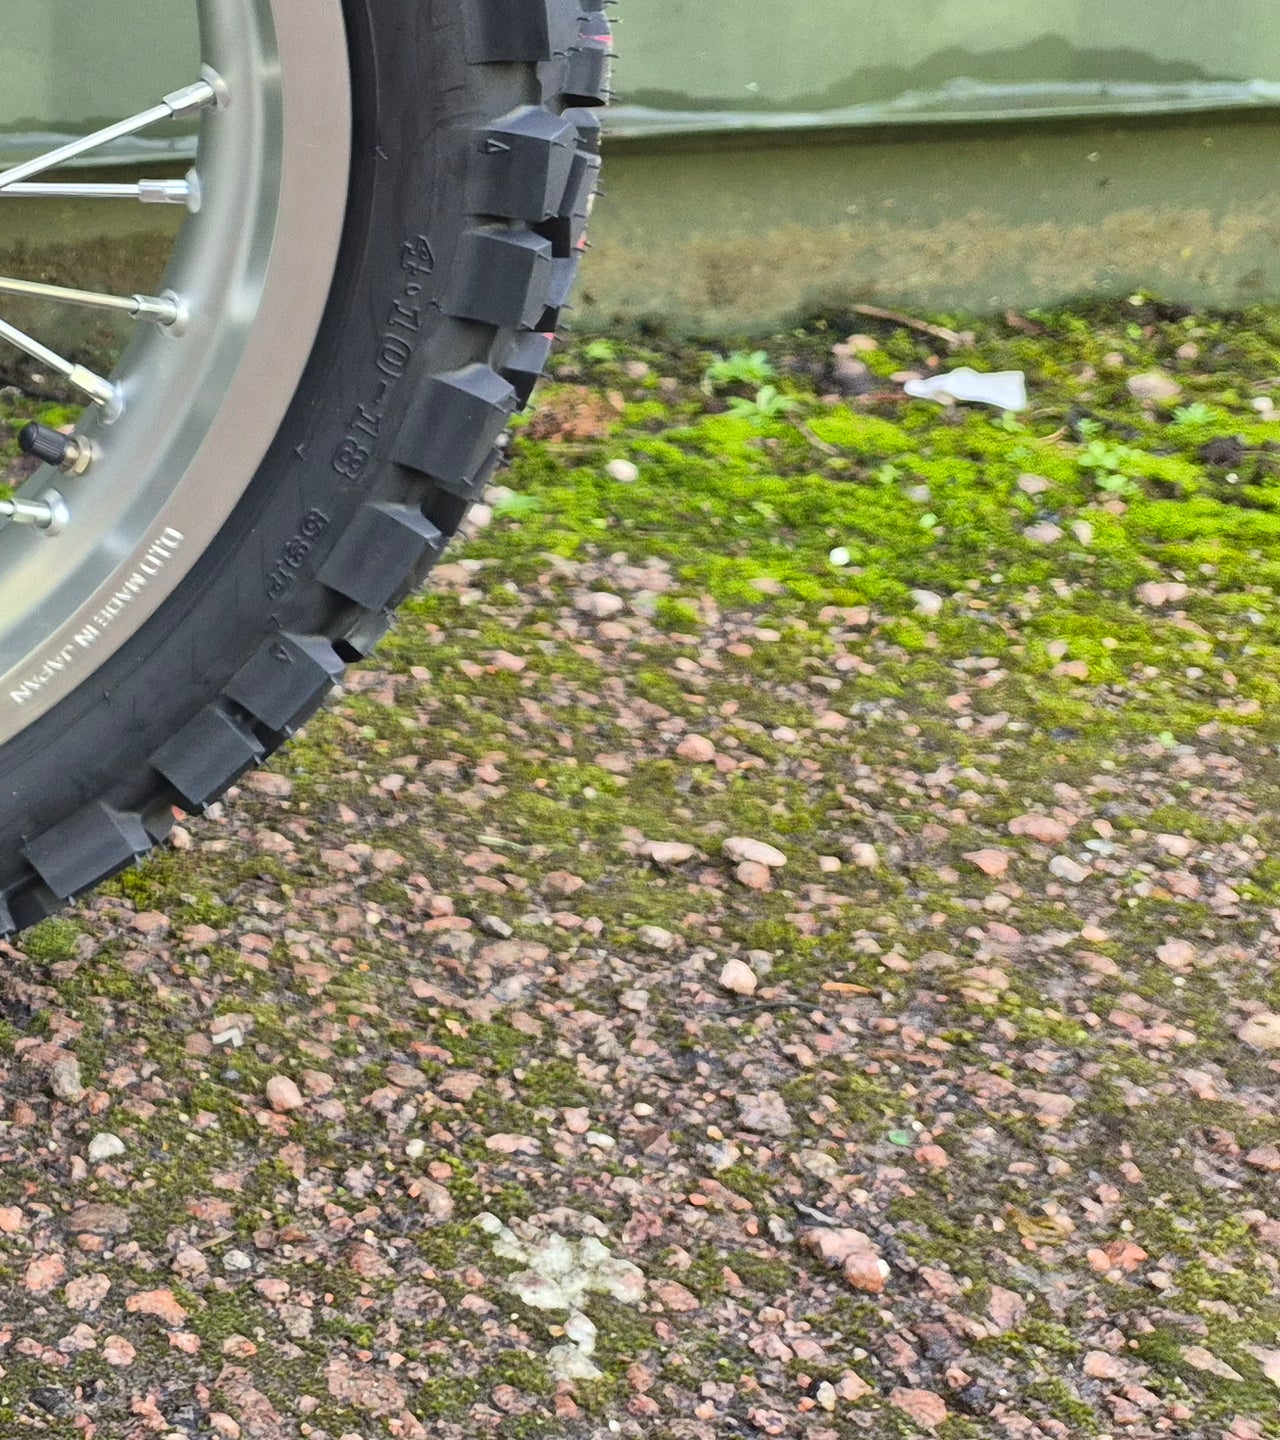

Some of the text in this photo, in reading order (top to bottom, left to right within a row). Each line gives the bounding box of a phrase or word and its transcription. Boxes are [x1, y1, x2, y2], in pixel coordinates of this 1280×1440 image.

[93, 572, 147, 628] MADE
[74, 624, 101, 648] IN
[10, 644, 76, 705] JAPAN
